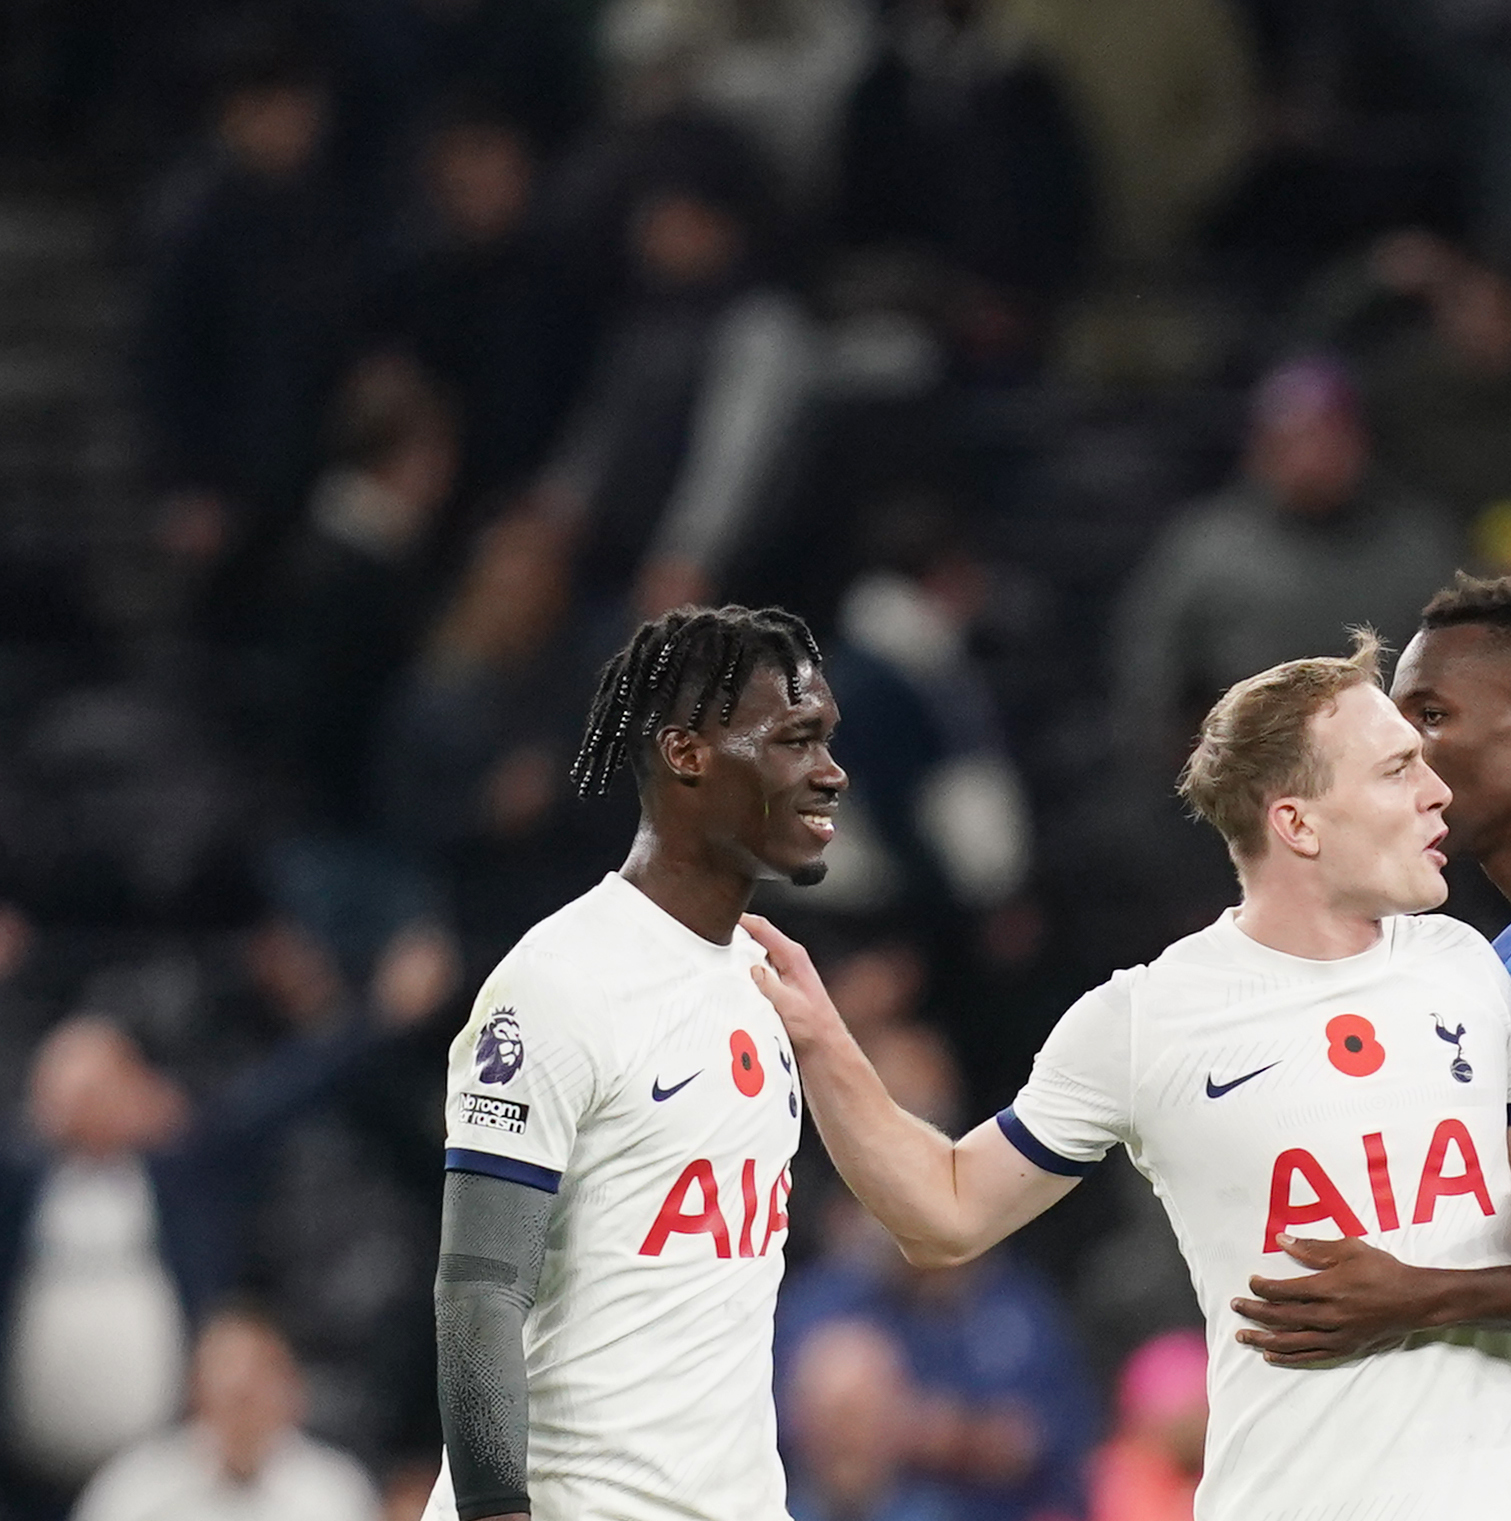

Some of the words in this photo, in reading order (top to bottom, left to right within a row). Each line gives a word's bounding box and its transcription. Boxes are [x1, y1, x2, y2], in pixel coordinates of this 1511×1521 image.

[472, 1111, 526, 1135] racism
[475, 1098, 521, 1119] room
[637, 1158, 793, 1259] AIA
[1262, 1118, 1496, 1254] AIA
